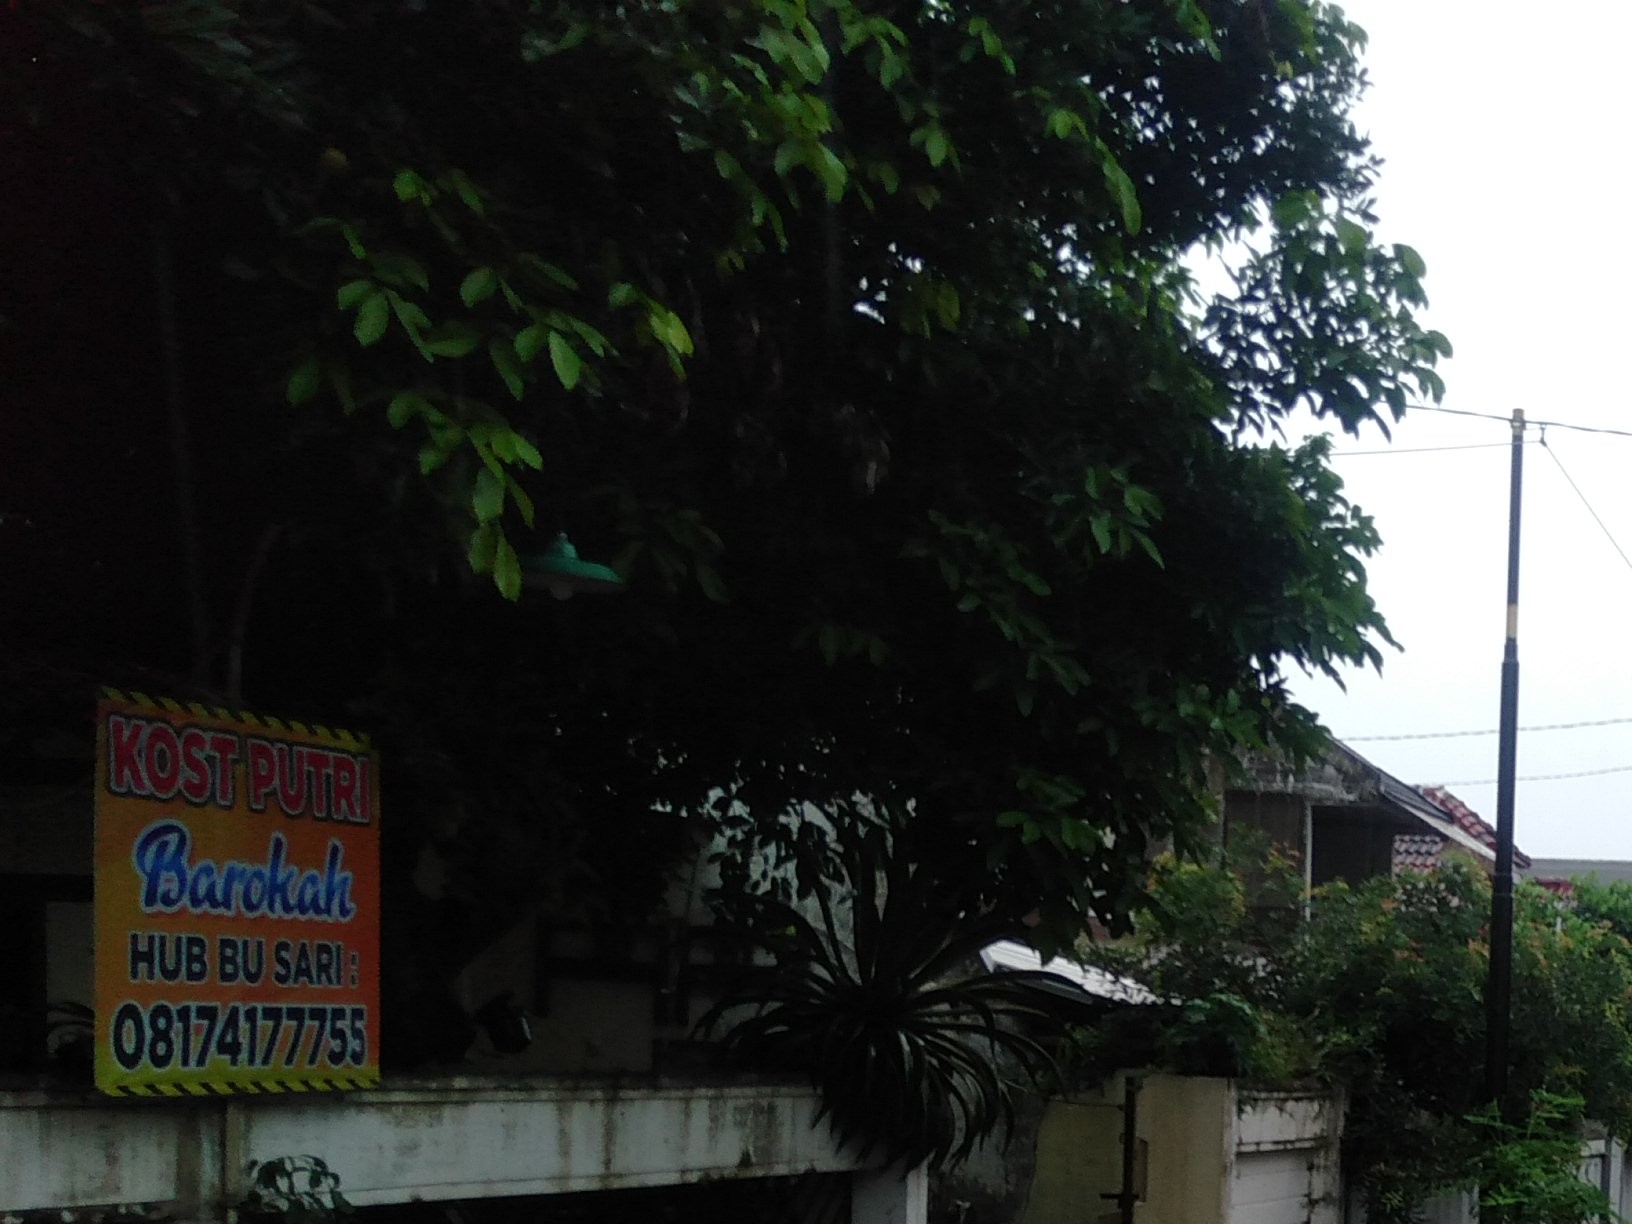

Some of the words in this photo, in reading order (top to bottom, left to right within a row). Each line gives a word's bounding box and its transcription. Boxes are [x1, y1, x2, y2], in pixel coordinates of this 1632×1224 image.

[110, 716, 237, 806] KOST
[248, 741, 370, 823] PUTRI
[134, 819, 356, 921] Barokah
[129, 932, 208, 983] HUB
[217, 936, 264, 984] BU
[273, 940, 343, 987] SARI
[112, 1001, 368, 1071] 08174177755
